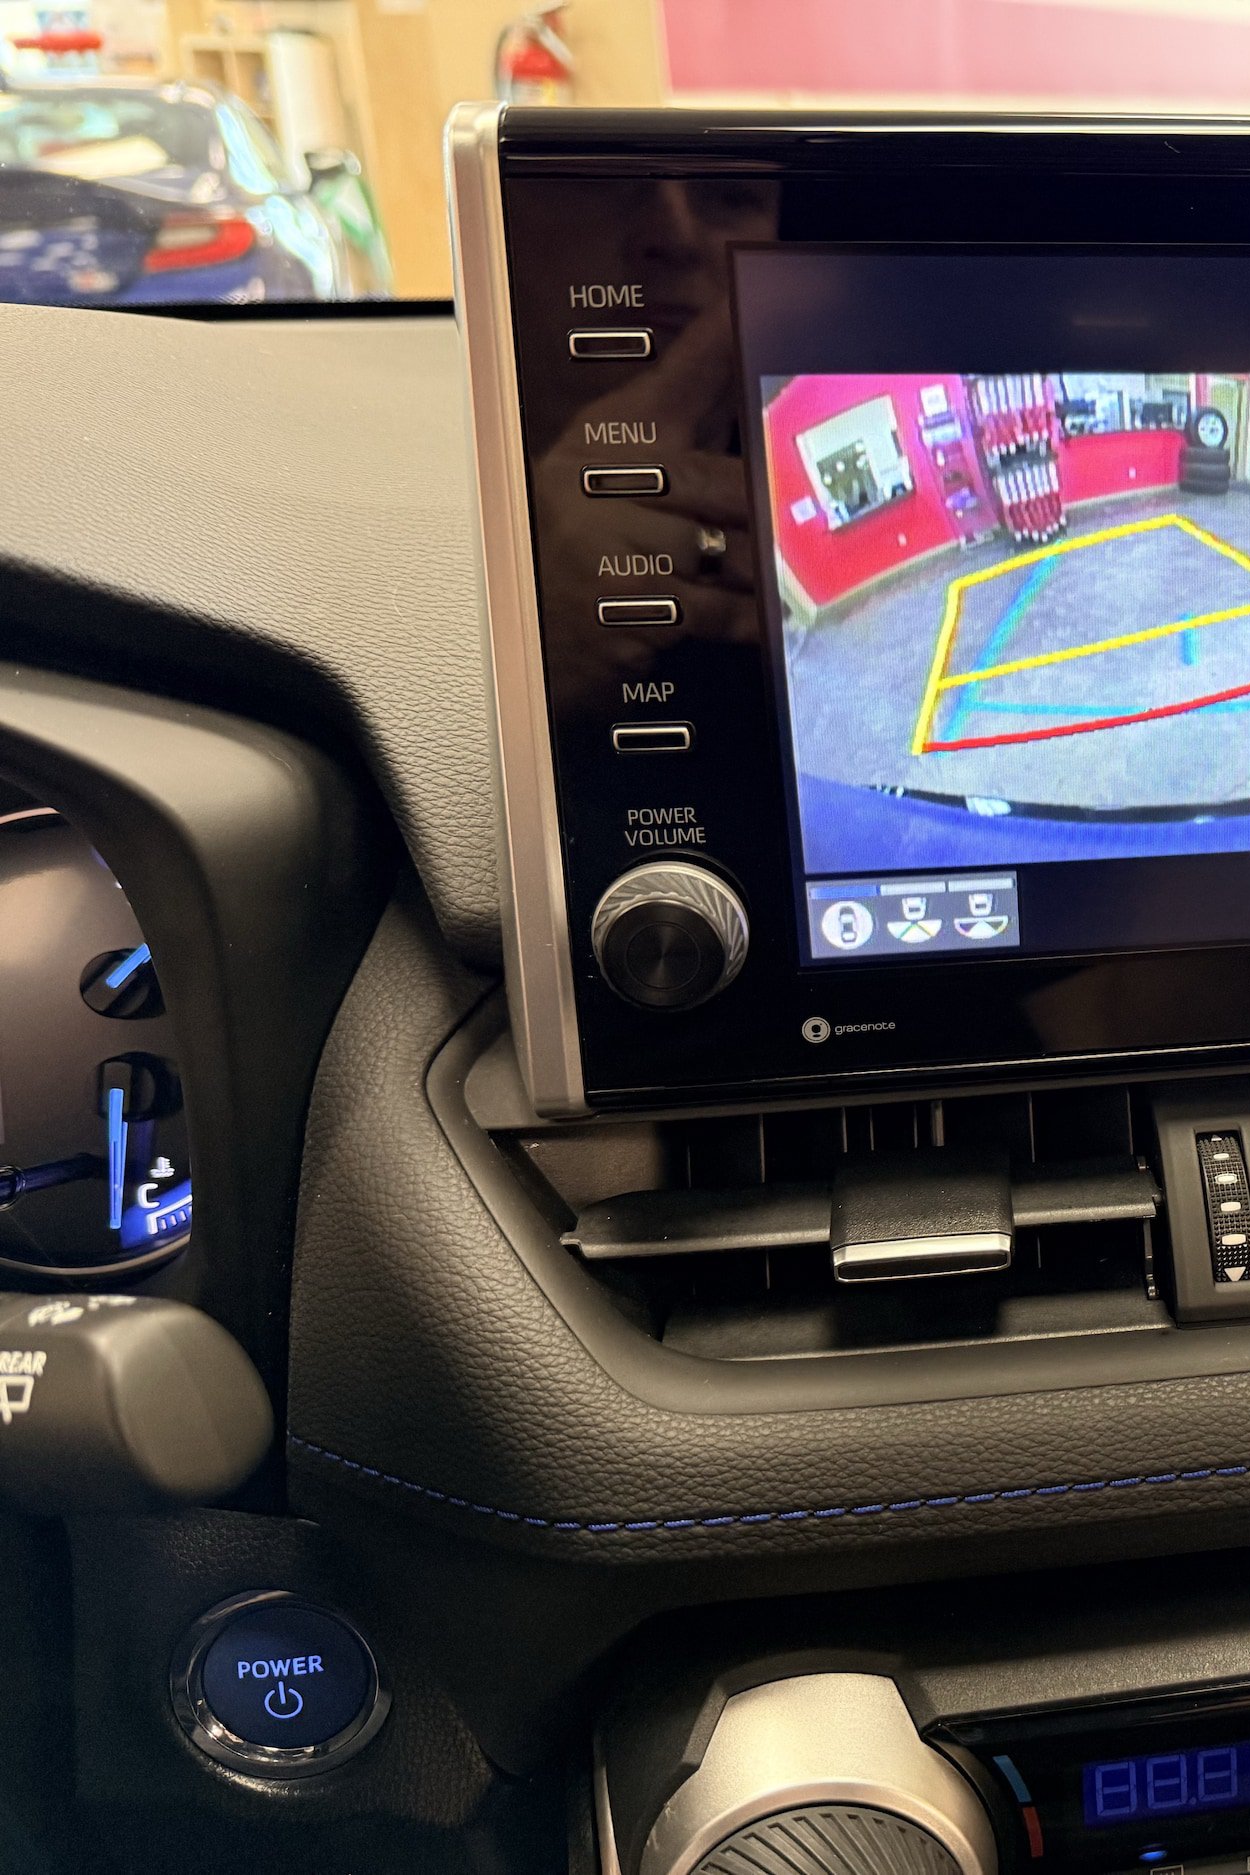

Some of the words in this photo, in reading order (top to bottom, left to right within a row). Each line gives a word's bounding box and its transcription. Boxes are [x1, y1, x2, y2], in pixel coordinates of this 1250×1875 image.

[569, 284, 645, 308] HOME
[584, 421, 657, 445] MENU
[598, 554, 674, 576] AUDIO
[622, 682, 675, 703] MAP
[627, 807, 697, 825] POWER
[624, 827, 707, 847] VOLUME
[834, 1021, 896, 1036] gracenote
[0, 1351, 47, 1377] REAR
[237, 1654, 325, 1679] POWER
